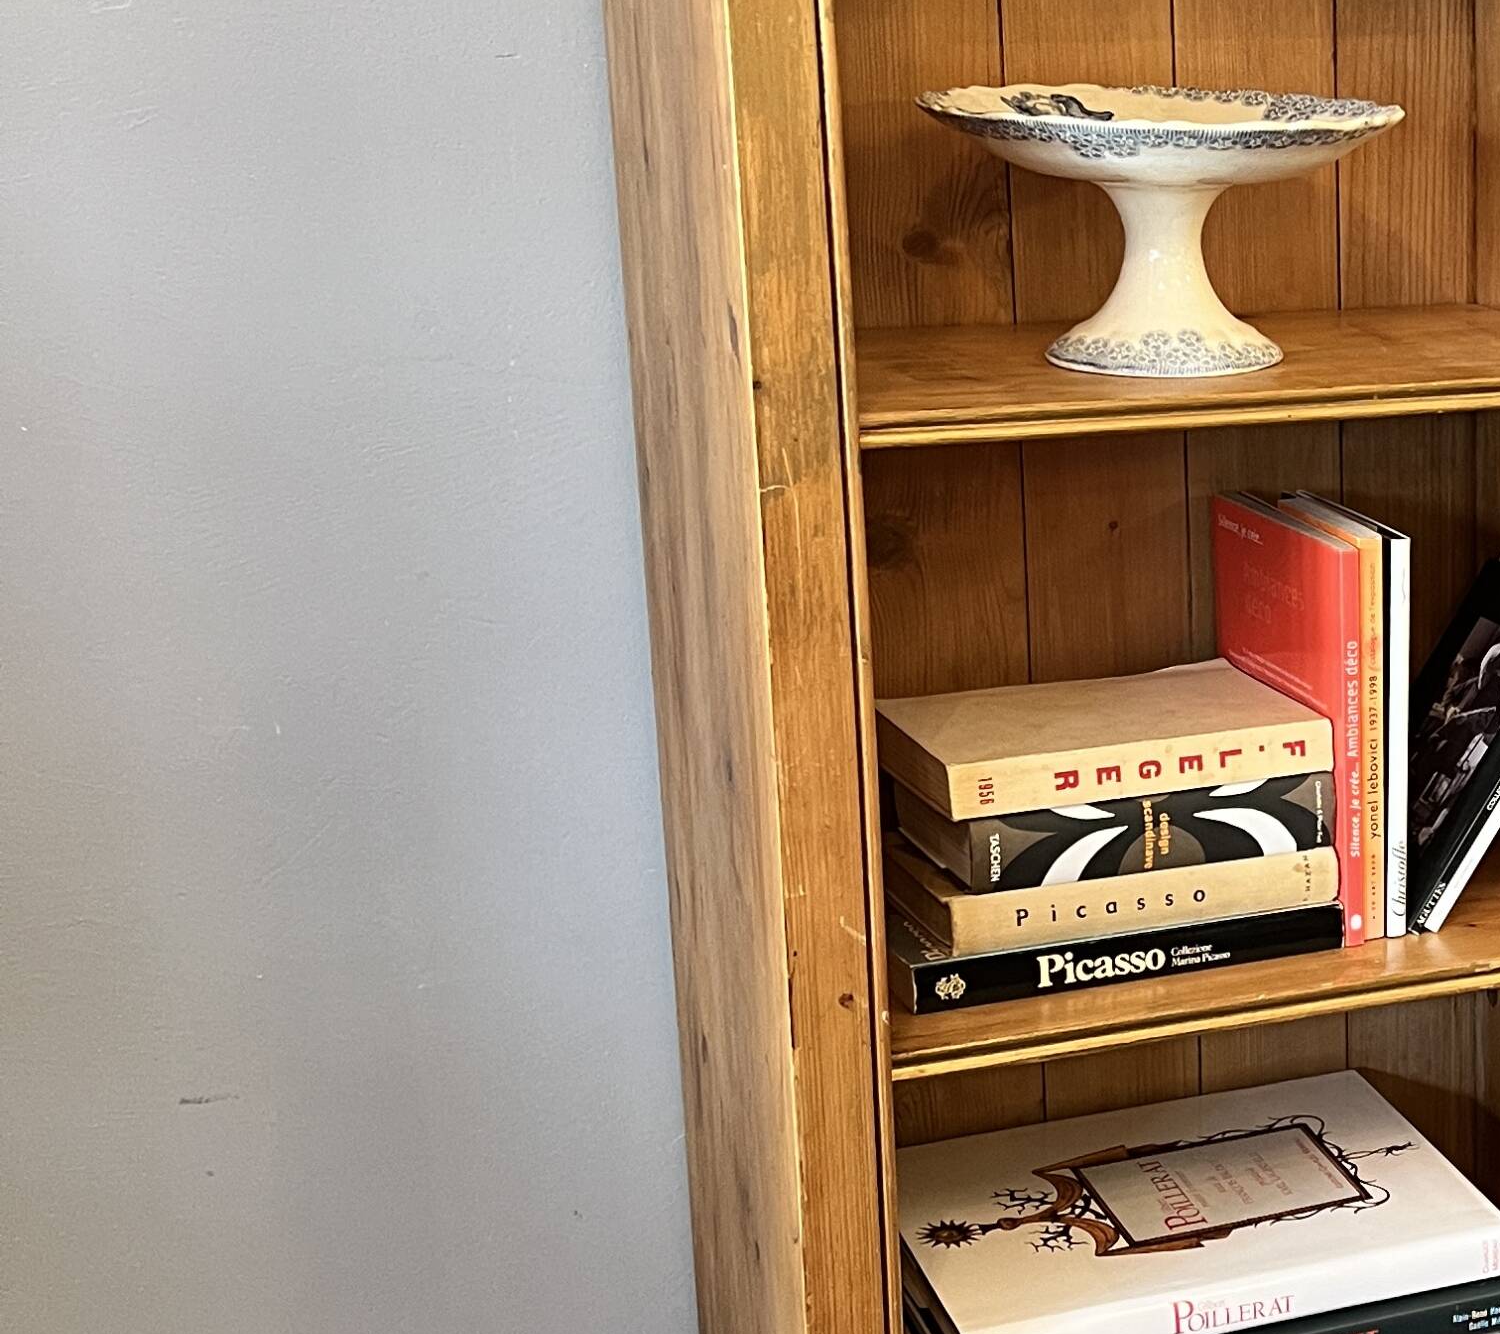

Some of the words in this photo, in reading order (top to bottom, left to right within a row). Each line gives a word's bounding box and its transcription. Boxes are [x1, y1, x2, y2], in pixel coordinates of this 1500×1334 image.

[1345, 640, 1359, 676] déco
[1346, 679, 1359, 758] Ambiances
[1369, 675, 1379, 731] 1937-1998
[1367, 738, 1379, 796] lebovici
[977, 775, 996, 806] 1956
[1142, 799, 1156, 869] scandinave
[1159, 812, 1171, 855] design
[1366, 798, 1382, 840] yonel
[989, 832, 1001, 883] TASCHEN
[1016, 889, 1207, 927] Picasso
[1036, 947, 1167, 989] Picasso
